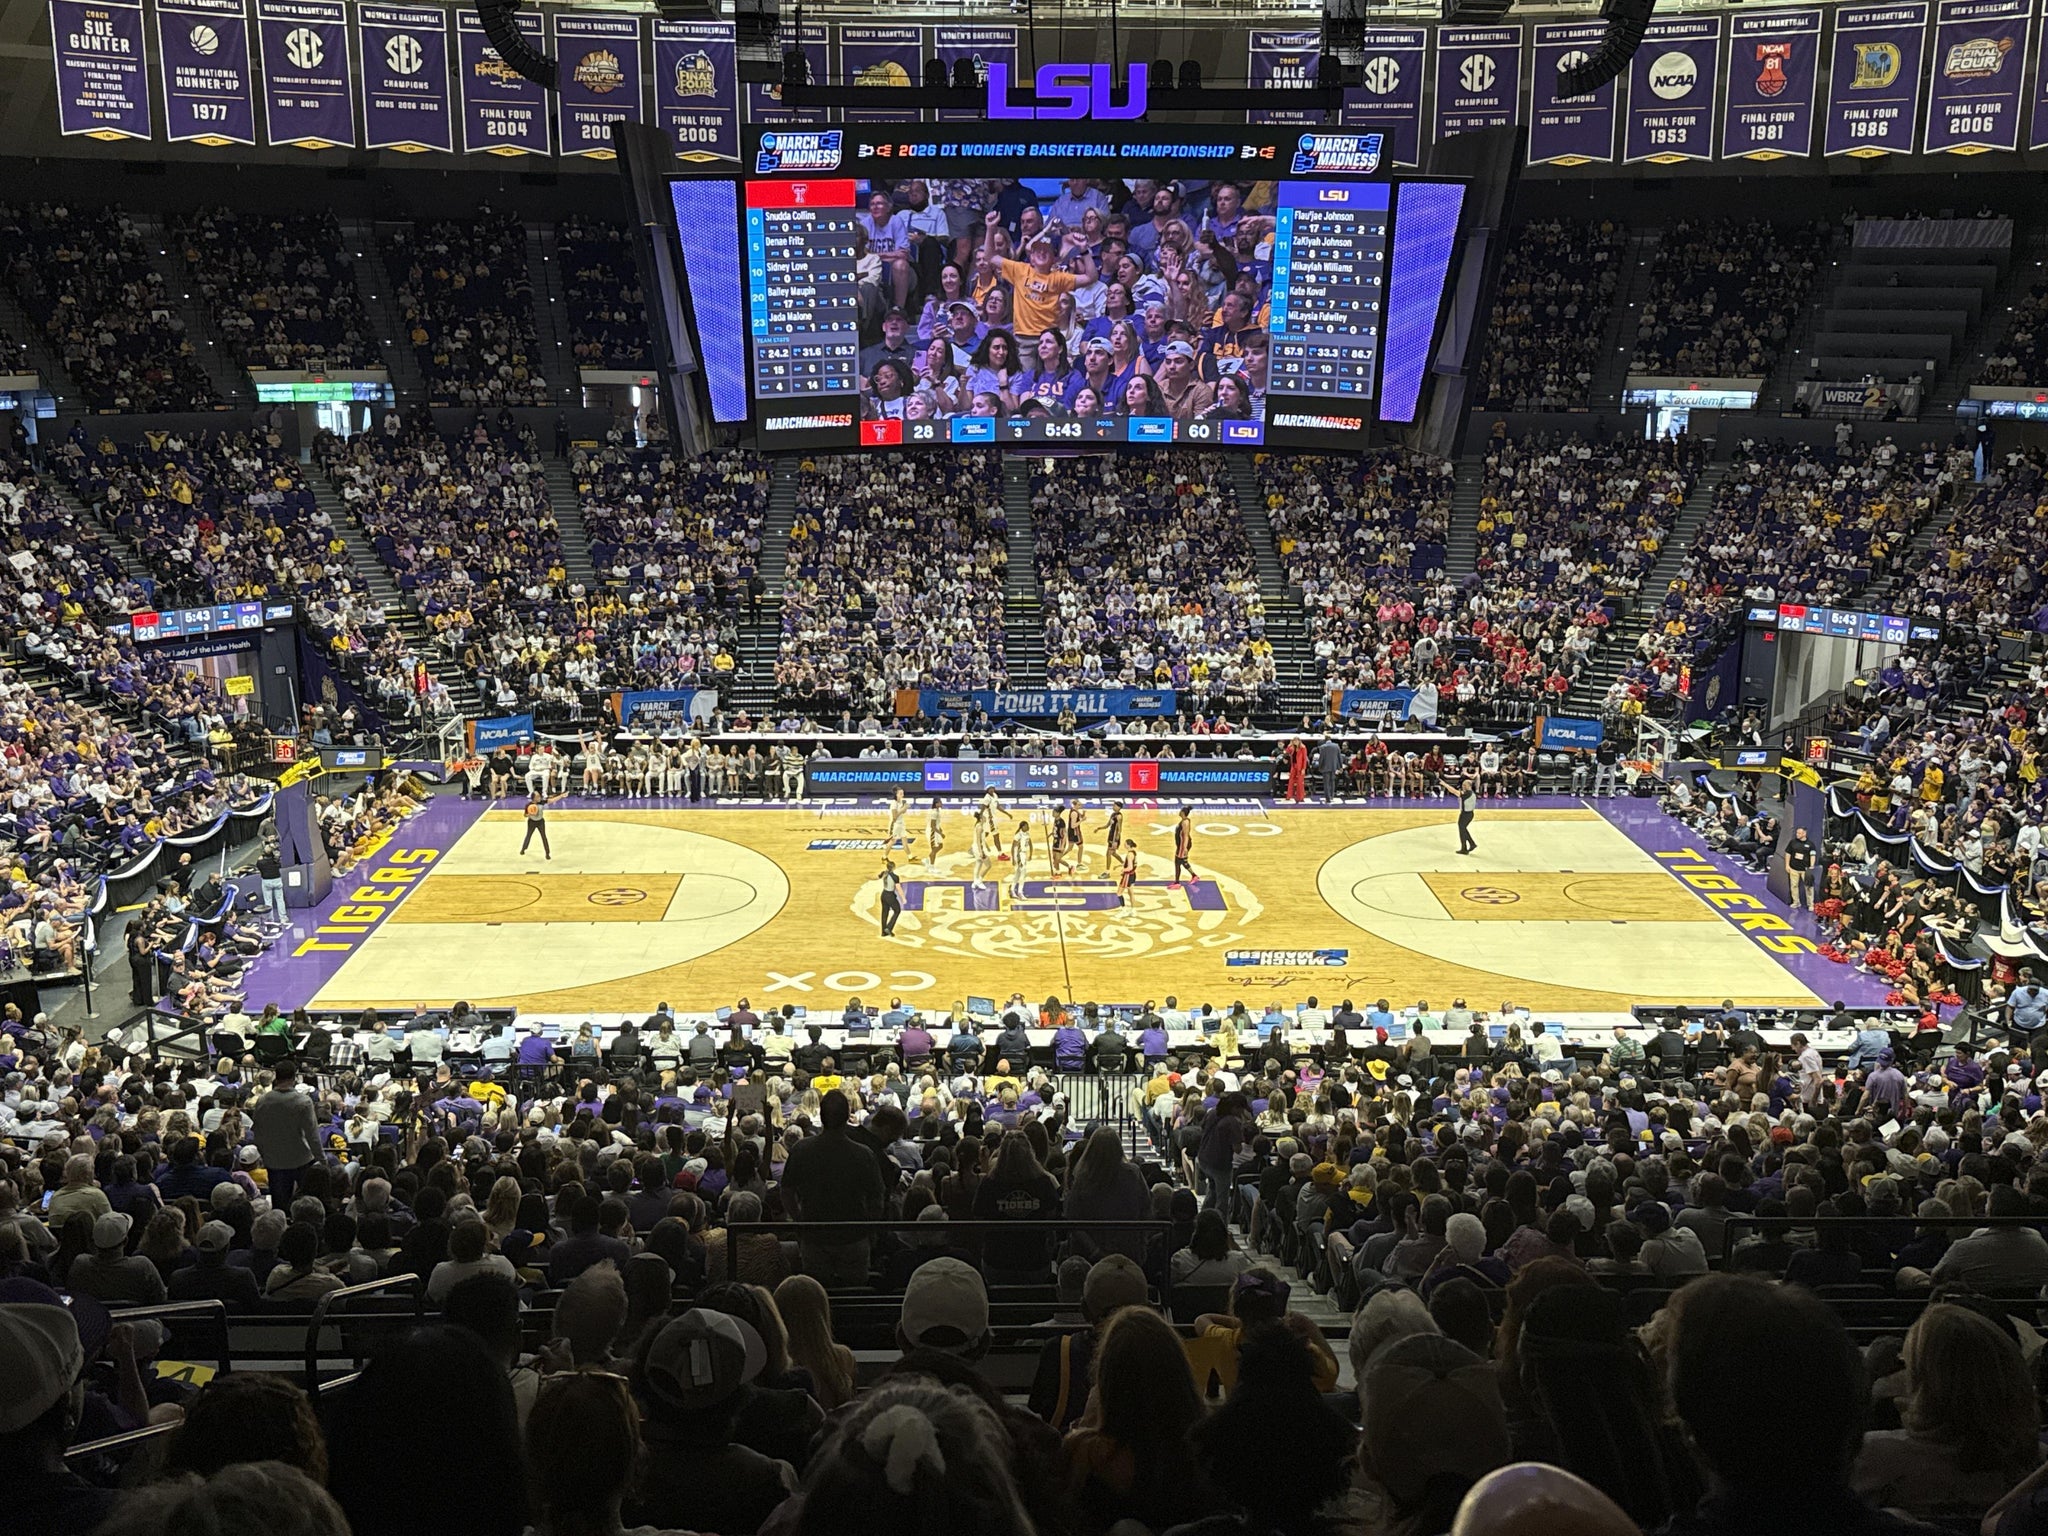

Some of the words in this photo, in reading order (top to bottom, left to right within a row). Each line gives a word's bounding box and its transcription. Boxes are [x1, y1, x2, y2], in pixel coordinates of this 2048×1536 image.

[264, 4, 297, 14] WOMEN'S
[298, 6, 340, 16] BASKETBALL
[1950, 5, 1973, 14] MEN'S
[1974, 2, 2020, 13] BASKETBALL
[86, 10, 109, 19] COACH
[365, 10, 397, 20] WOMEN'S
[399, 14, 440, 24] BASKETBALL
[1848, 13, 1870, 22] MEN'S
[1872, 10, 1915, 21] BASKETBALL
[84, 20, 114, 36] SUE
[560, 21, 592, 30] WOMEN'S
[594, 23, 633, 32] BASKETBALL
[1667, 24, 1708, 34] BASKETBALL
[1743, 20, 1765, 28] MEN'S
[1766, 18, 1809, 28] BASKETBALL
[658, 25, 688, 34] WOMEN'S
[690, 26, 731, 35] BASKETBALL
[846, 29, 876, 37] WOMEN'S
[878, 30, 916, 38] BASKETBALL
[941, 32, 971, 40] WOMEN'S
[972, 32, 1012, 40] BASKETBALL
[1546, 30, 1567, 38] MEN'S
[70, 34, 130, 52] GUNTER
[1376, 34, 1415, 43] BASKETBALL
[1449, 34, 1470, 42] MEN'S
[1471, 33, 1511, 41] BASKETBALL
[285, 28, 324, 68] SEC
[385, 34, 423, 74] SEC
[1962, 48, 1998, 59] FINAL
[1766, 58, 1780, 70] 81
[1950, 58, 1997, 70] FOUR
[176, 66, 197, 77] AIAW
[200, 68, 238, 78] NATIONAL
[578, 74, 601, 82] FINAL
[600, 73, 624, 81] FOUR
[679, 71, 711, 82] FINAL
[1272, 66, 1306, 78] DALE
[1365, 56, 1400, 94] SEC
[1460, 54, 1496, 92] SEC
[176, 76, 240, 91] RUNNER-UP
[272, 76, 309, 84] TOURNAMENT
[310, 78, 342, 86] CHAMPIONS
[384, 80, 430, 90] CHAMPIONS
[679, 80, 713, 90] FOUR
[1264, 79, 1312, 89] BROWN
[1654, 74, 1694, 88] NCAA
[987, 63, 1148, 120] LSU
[76, 98, 96, 107] COACH
[97, 100, 105, 108] OF
[106, 100, 118, 108] THE
[119, 102, 134, 110] YEAR
[1349, 102, 1382, 110] TOURNAMENT
[1384, 102, 1414, 110] CHAMPIONS
[1454, 98, 1499, 106] CHAMPIONS
[192, 104, 228, 121] 1977
[480, 108, 506, 120] FINAL
[508, 110, 532, 120] FOUR
[1844, 109, 1870, 120] FINAL
[1874, 108, 1898, 118] FOUR
[1946, 104, 1972, 116] FINAL
[1974, 102, 2002, 114] FOUR
[574, 112, 600, 122] FINAL
[602, 114, 626, 122] FOUR
[672, 116, 697, 126] FINAL
[700, 116, 723, 126] FOUR
[1644, 117, 1669, 128] FINAL
[1672, 116, 1696, 126] FOUR
[1742, 112, 1767, 124] FINAL
[1770, 112, 1795, 122] FOUR
[486, 121, 528, 137] 2004
[1850, 122, 1888, 137] 1986
[1950, 117, 1994, 134] 2006
[582, 125, 611, 140] 200
[678, 127, 718, 143] 2006
[1650, 128, 1688, 144] 1953
[1750, 125, 1784, 140] 1981
[776, 136, 819, 149] MARCH
[1313, 138, 1359, 152] MARCH
[781, 150, 840, 164] MADNESS
[899, 144, 936, 157] 2026
[940, 144, 957, 156] DI
[961, 144, 1026, 156] WOMEN'S
[1029, 144, 1117, 157] BASKETBALL
[1120, 145, 1234, 158] CHAMPIONSHIP
[1317, 152, 1378, 167] MADNESS
[1319, 190, 1350, 202] LSU
[792, 210, 816, 220] Collins
[1324, 211, 1354, 222] Johnson
[766, 237, 788, 246] Denae
[789, 236, 804, 246] Fritz
[1322, 237, 1353, 247] Johnson
[766, 262, 790, 273] Sidney
[791, 262, 808, 272] Love
[1324, 262, 1353, 272] Williams
[768, 288, 790, 298] Bailey
[790, 286, 816, 297] Maupin
[1290, 286, 1306, 296] Kate
[1306, 286, 1326, 296] Koval
[769, 312, 786, 322] Jada
[787, 312, 813, 322] Malone
[1674, 395, 1726, 408] accutemp
[1825, 390, 1864, 403] WBRZ
[1863, 388, 1881, 408] 2
[766, 414, 852, 430] MARCHMADNESS
[1272, 414, 1362, 431] MARCHMADNESS
[913, 426, 934, 440] 28
[1014, 428, 1022, 438] 3
[1045, 423, 1082, 438] 5:43
[1188, 424, 1210, 438] 60
[1229, 426, 1258, 438] LSU
[185, 610, 211, 623] 5:43
[242, 614, 259, 627] 60
[1831, 614, 1857, 626] 5:43
[1782, 617, 1800, 629] 28
[138, 626, 156, 640] 28
[1886, 630, 1905, 642] 60
[172, 648, 190, 659] Lady
[190, 646, 198, 655] of
[200, 644, 210, 654] the
[212, 642, 228, 652] Lake
[229, 640, 251, 650] Health
[640, 700, 670, 712] MARCH
[994, 691, 1046, 714] FOUR
[1050, 691, 1069, 713] IT
[1074, 691, 1108, 714] ALL
[1359, 700, 1389, 710] MARCH
[643, 710, 684, 720] MADNESS
[1362, 708, 1402, 719] MADNESS
[480, 728, 528, 741] NCAA.com
[1548, 728, 1598, 742] NCAA.com
[1810, 748, 1824, 758] 30
[1029, 764, 1058, 776] 5:43
[811, 771, 922, 783] #MARCHMADNESS
[928, 772, 950, 781] LSU
[960, 772, 980, 784] 60
[1104, 772, 1123, 784] 28
[1160, 772, 1270, 783] #MARCHMADNESS
[1149, 823, 1284, 837] COX
[291, 848, 440, 957] TIGERS
[1654, 848, 1818, 954] TIGERS
[1227, 951, 1314, 959] MADNESS
[1260, 958, 1326, 966] MARCH
[762, 970, 937, 992] COX
